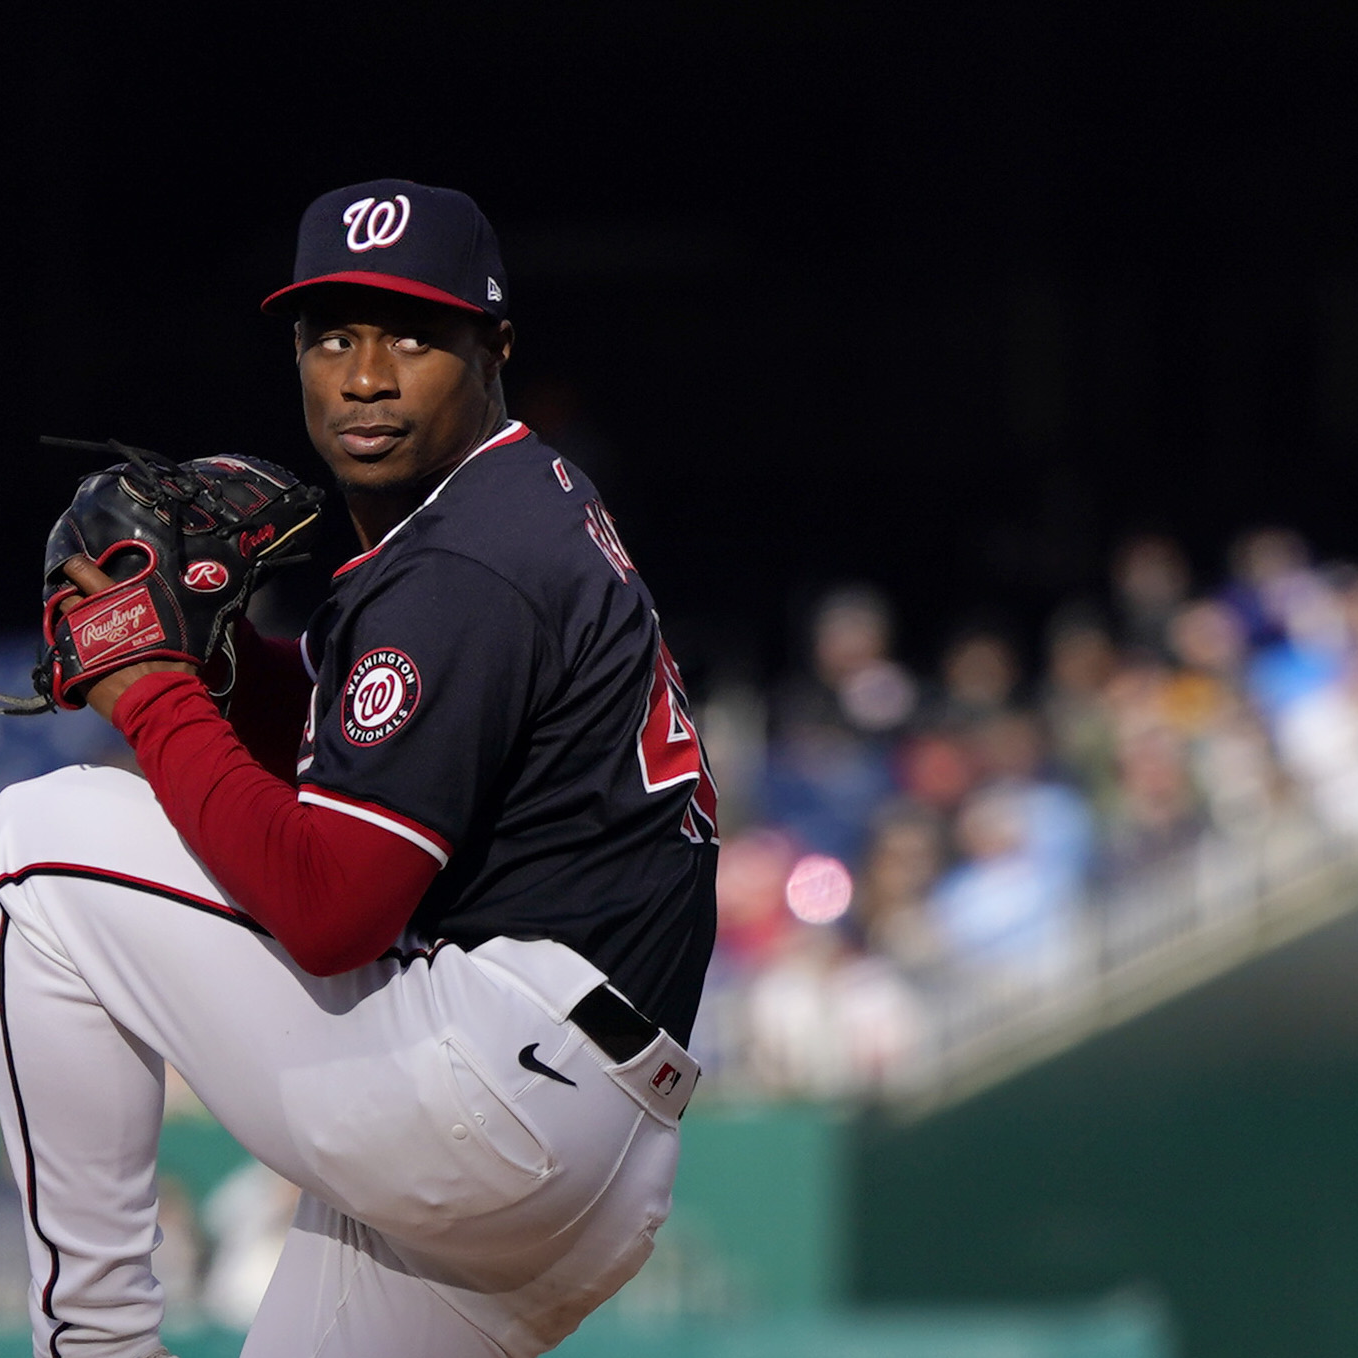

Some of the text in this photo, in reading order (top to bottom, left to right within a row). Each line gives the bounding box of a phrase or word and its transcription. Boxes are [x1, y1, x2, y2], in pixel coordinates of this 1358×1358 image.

[343, 194, 411, 253] W
[184, 561, 221, 586] R
[81, 604, 147, 647] Rawlings
[347, 653, 415, 695] WASHINGTON
[358, 673, 396, 721] W
[345, 709, 408, 742] NATIONALS
